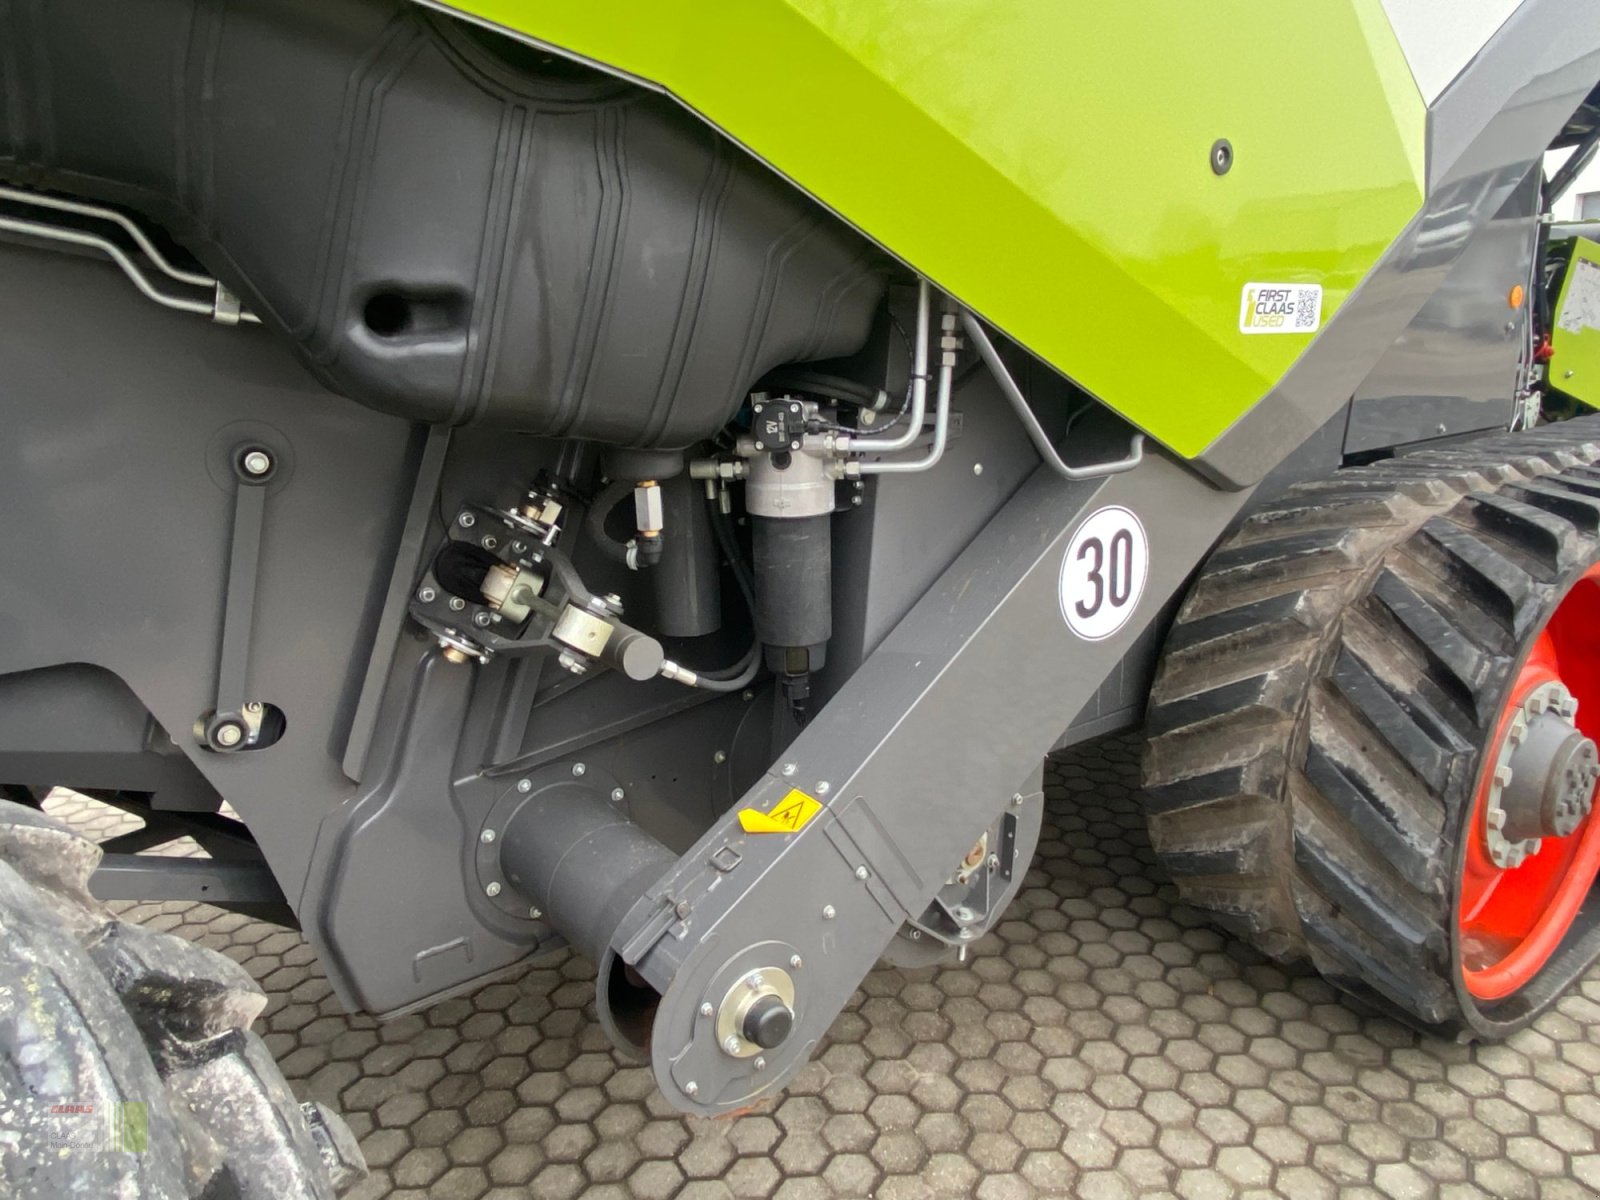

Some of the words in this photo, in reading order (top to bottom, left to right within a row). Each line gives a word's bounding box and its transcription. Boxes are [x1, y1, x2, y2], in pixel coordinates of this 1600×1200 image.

[1258, 289, 1292, 301] FIRST
[1256, 302, 1295, 315] CLAAS
[1253, 315, 1285, 327] USED
[766, 420, 778, 434] 12V
[1075, 528, 1133, 619] 30
